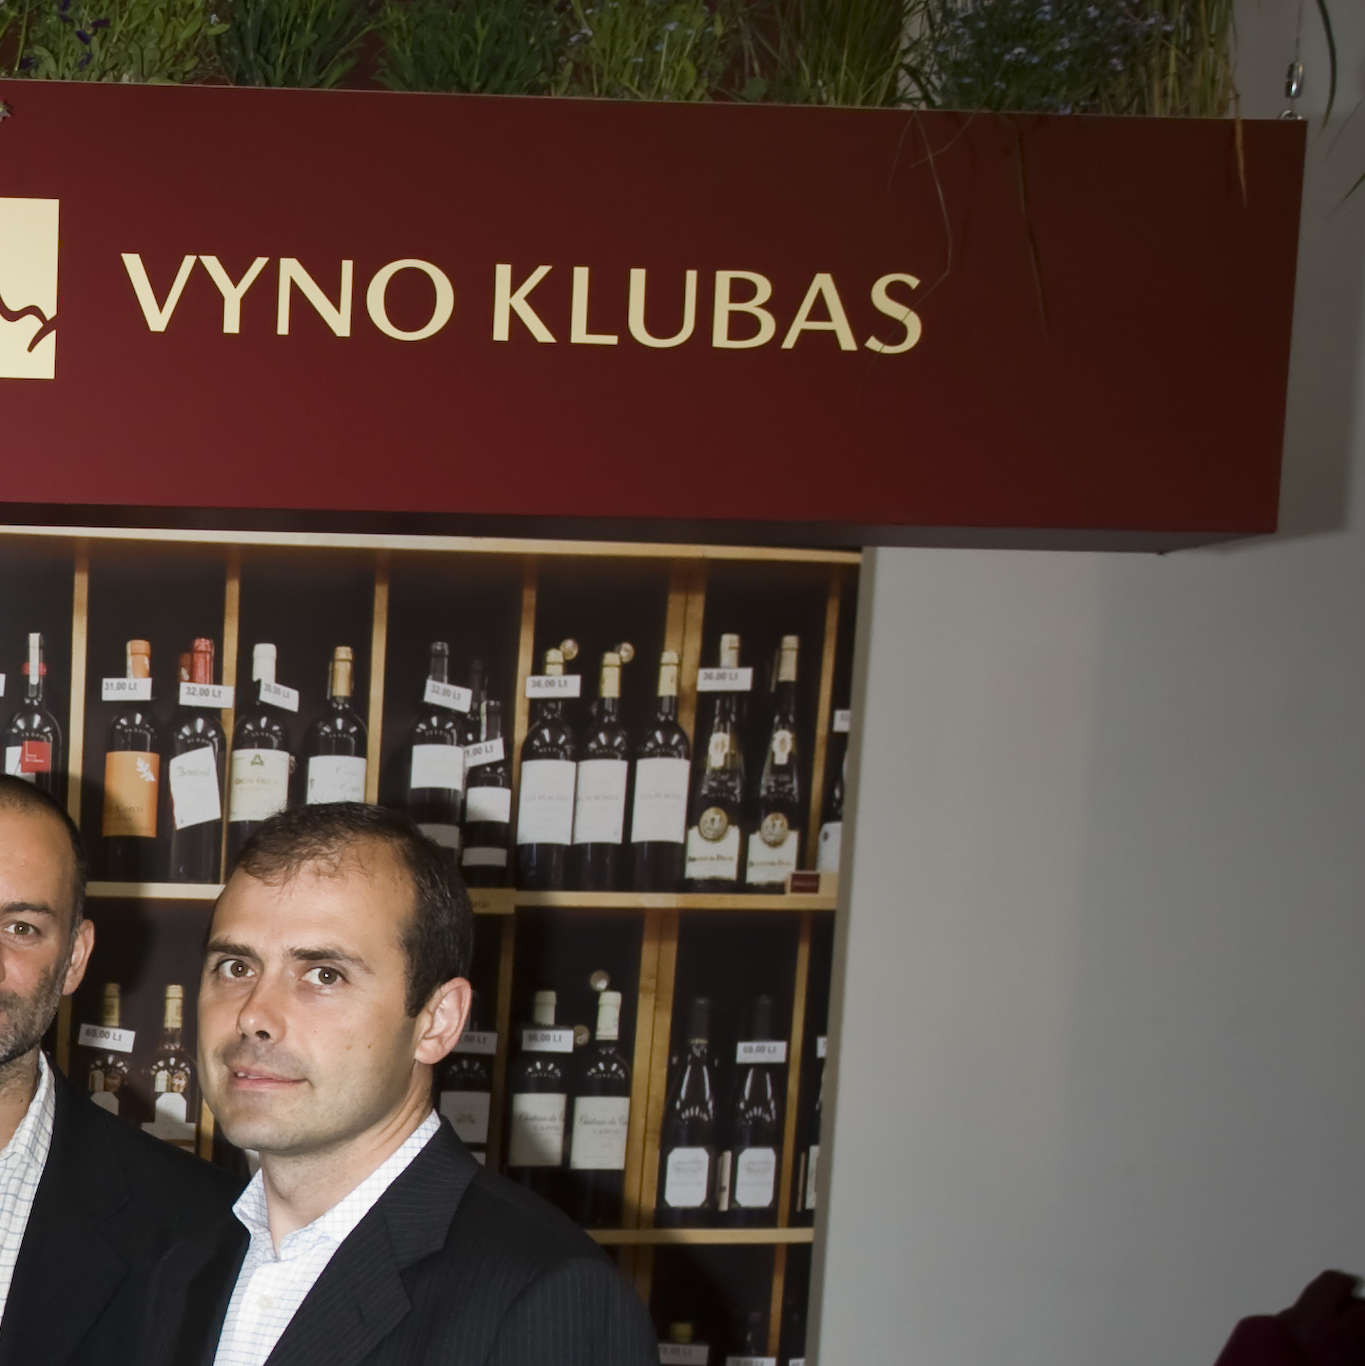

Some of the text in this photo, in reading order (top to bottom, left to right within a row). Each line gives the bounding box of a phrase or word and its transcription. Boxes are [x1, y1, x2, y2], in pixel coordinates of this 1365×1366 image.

[121, 252, 923, 354] VYNO KLUBAS
[185, 686, 211, 698] 32,00
